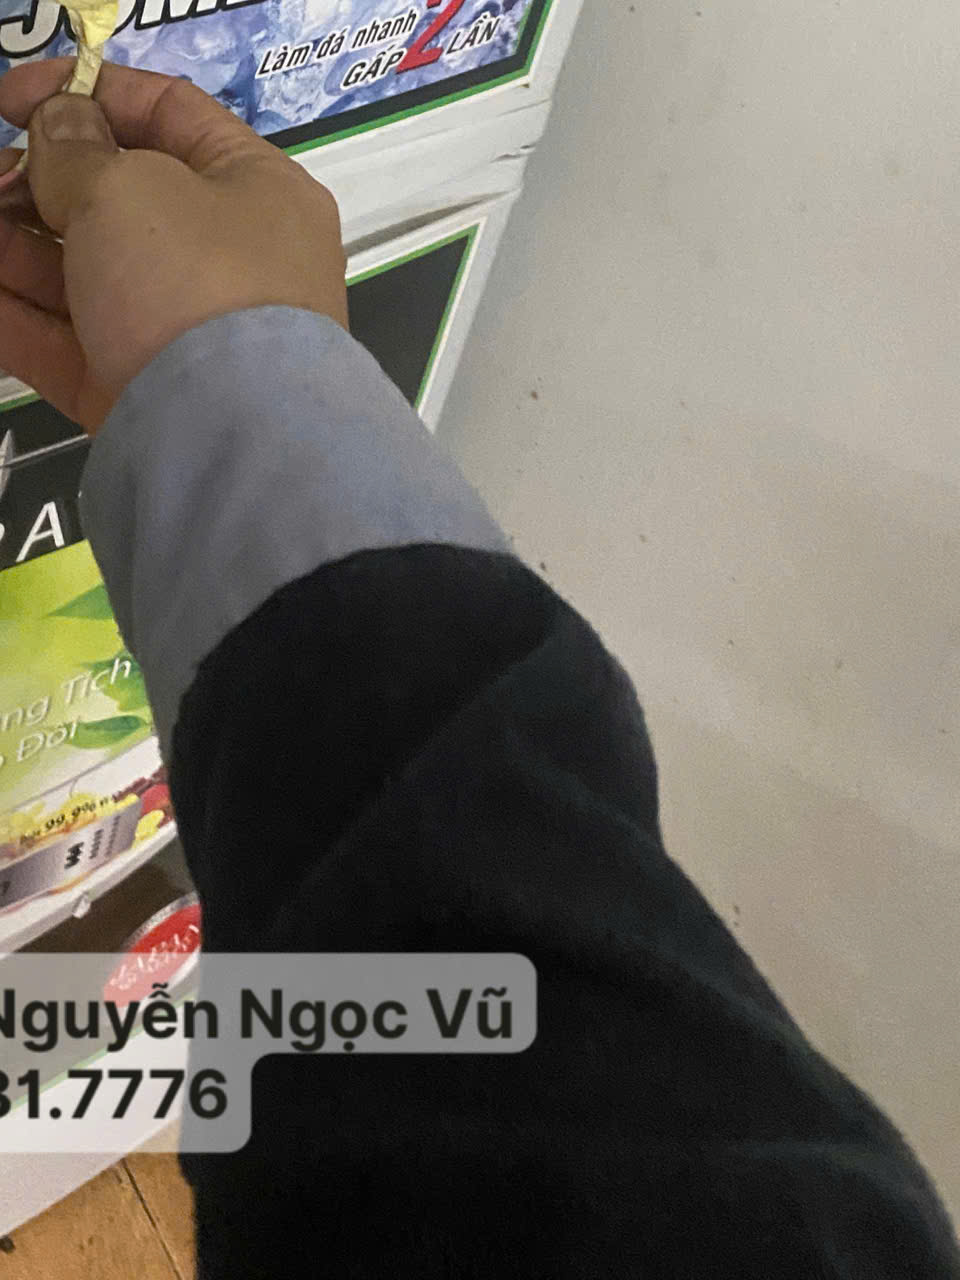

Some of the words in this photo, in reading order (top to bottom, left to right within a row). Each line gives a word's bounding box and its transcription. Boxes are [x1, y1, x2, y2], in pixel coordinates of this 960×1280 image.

[257, 45, 309, 76] Làm
[316, 27, 344, 59] đá
[351, 8, 419, 47] nhanh
[343, 45, 403, 89] GẤP
[446, 12, 501, 56] LẦN
[61, 656, 132, 706] Tích
[16, 716, 82, 764] Đôi
